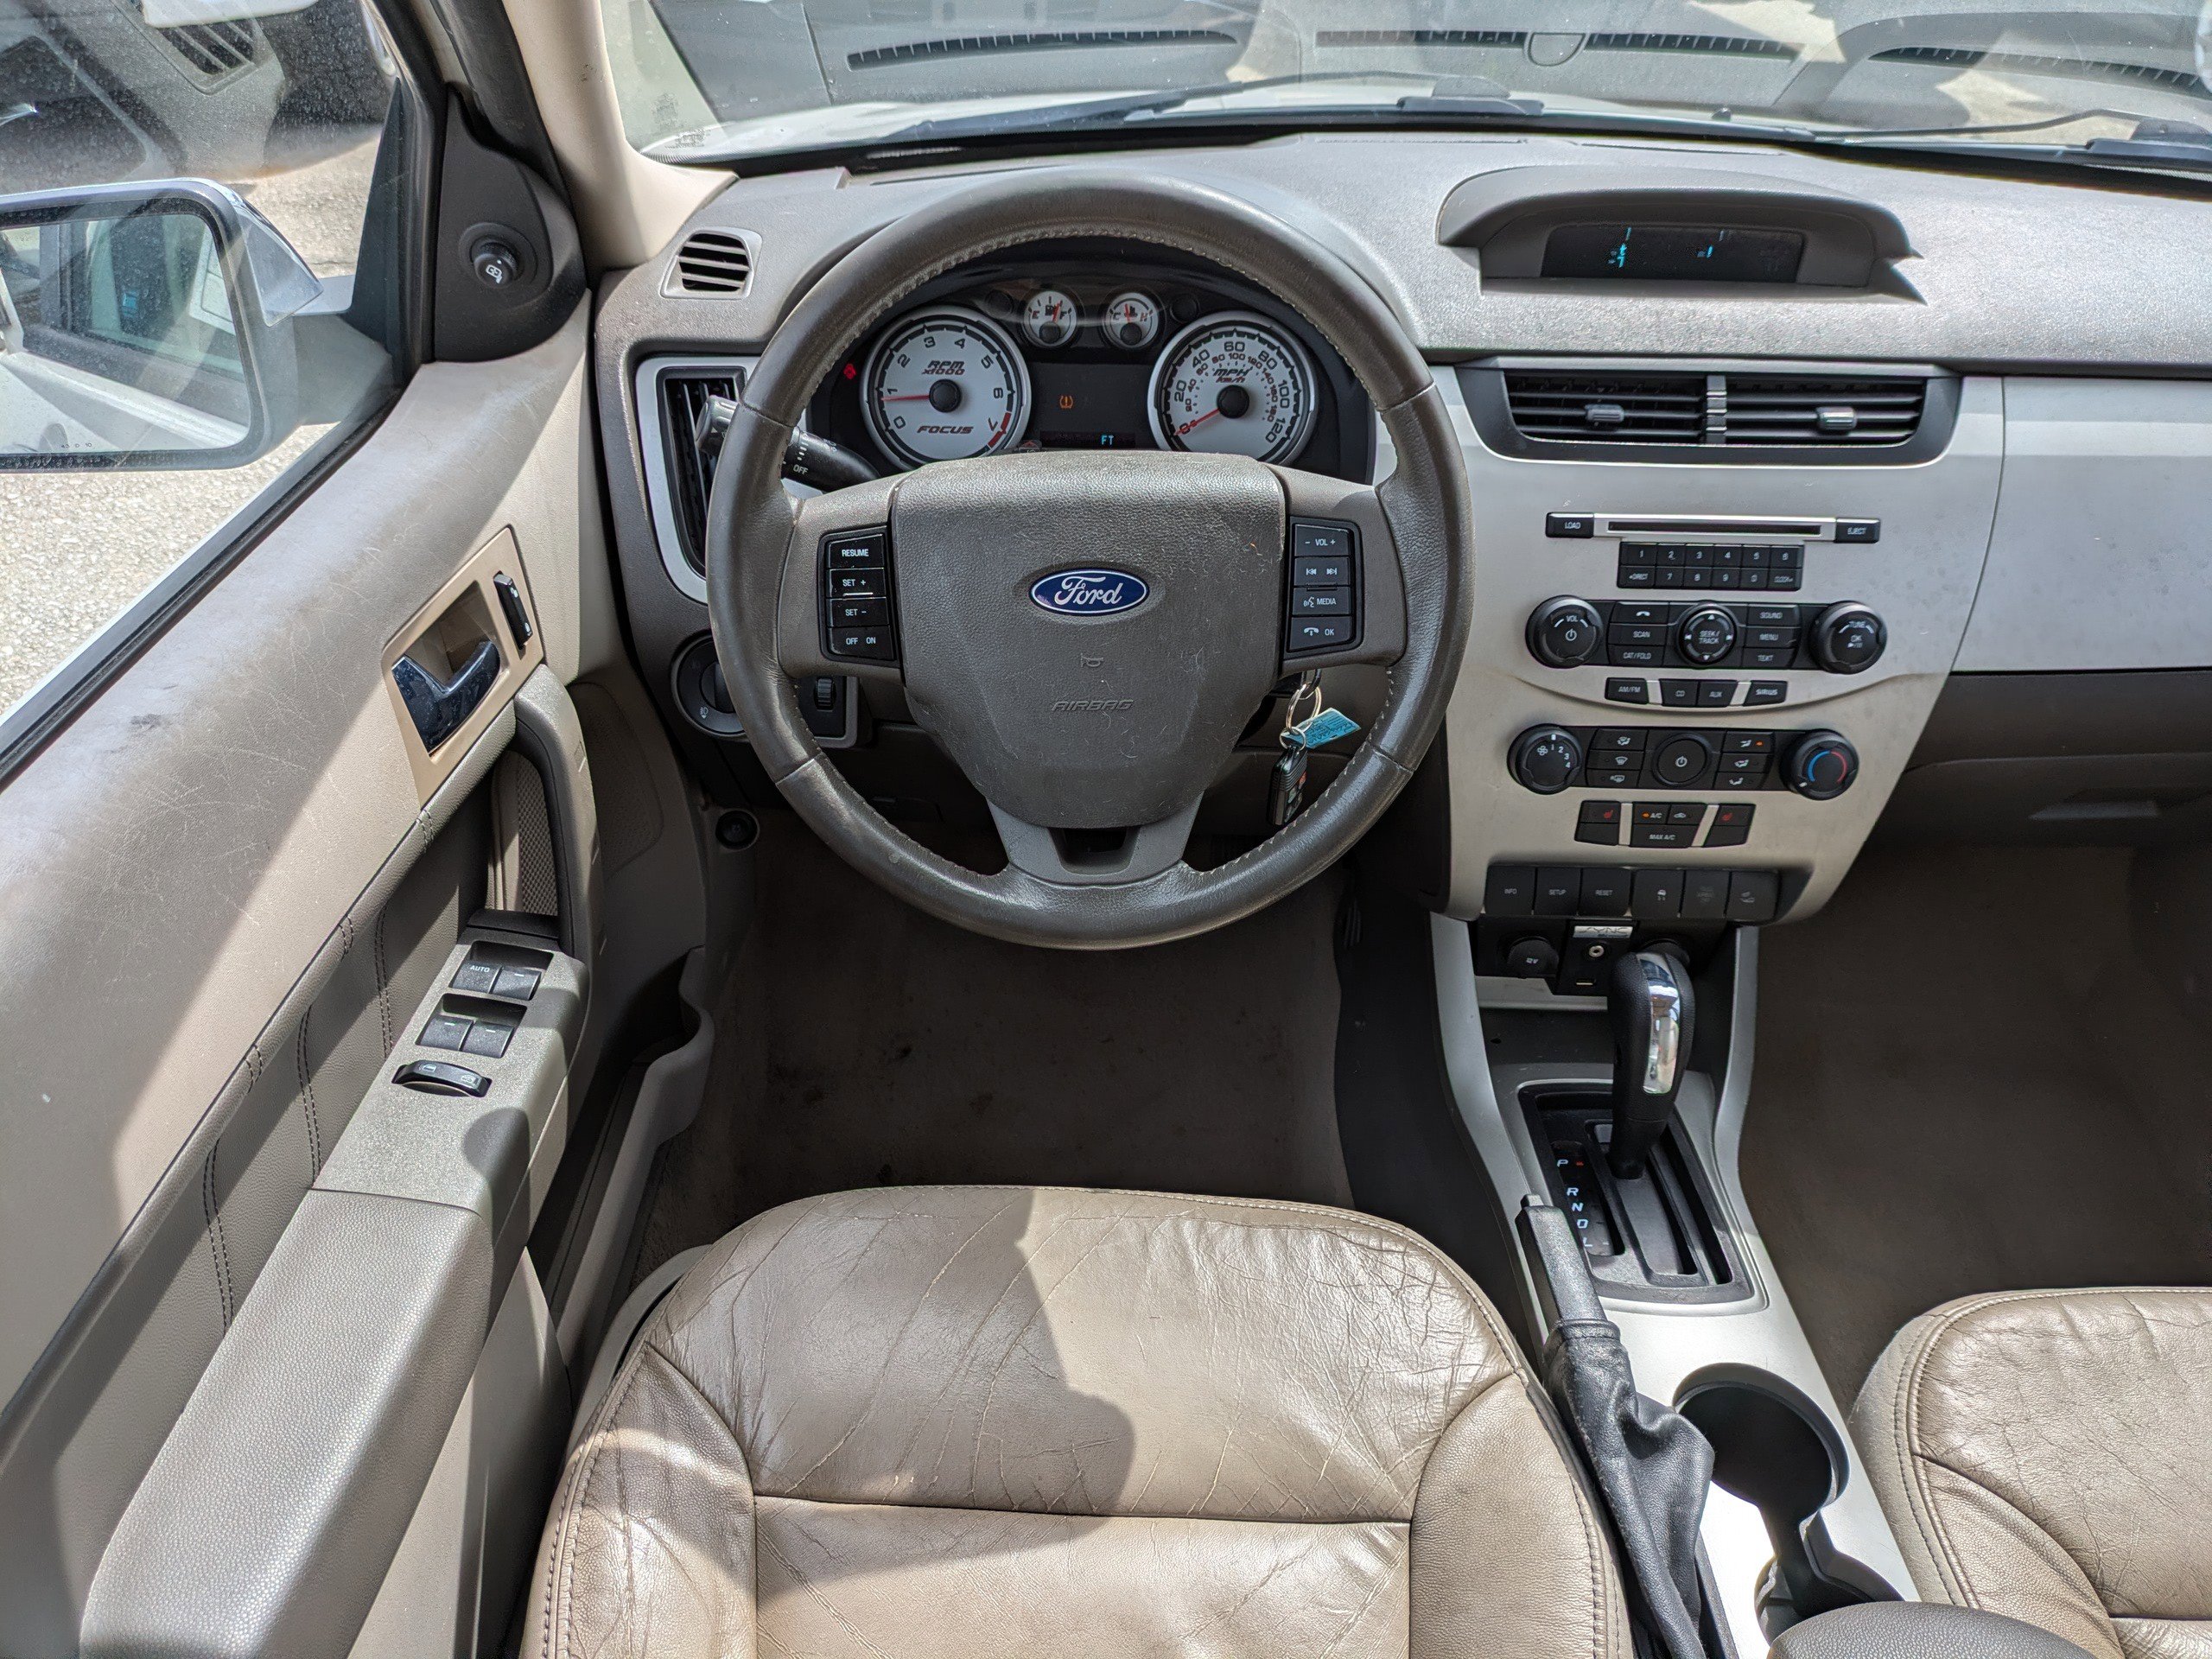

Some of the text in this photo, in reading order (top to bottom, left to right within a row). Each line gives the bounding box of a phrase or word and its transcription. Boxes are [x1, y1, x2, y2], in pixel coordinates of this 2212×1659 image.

[923, 336, 937, 349] 3
[954, 337, 966, 350] 4
[1224, 340, 1246, 353] 60
[897, 353, 912, 369] 2
[926, 359, 965, 368] RPM
[980, 354, 995, 370] 5
[1192, 349, 1211, 368] 40
[1257, 350, 1278, 371] 80
[1212, 368, 1249, 377] MPH
[993, 387, 1004, 400] 6
[1173, 379, 1187, 403] 20
[1278, 378, 1290, 410] 100
[893, 416, 906, 429] 0
[987, 417, 999, 432] 7
[916, 425, 974, 435] FOCUS
[1265, 417, 1286, 443] 120
[1101, 434, 1115, 446] FT
[793, 465, 809, 475] OFF
[842, 548, 869, 557] RESUME
[1695, 551, 1703, 560] 3
[1724, 551, 1732, 560] 4
[1666, 572, 1673, 581] 7
[842, 579, 856, 588] SET
[1054, 575, 1123, 605] Ford
[1316, 597, 1337, 606] MEDIA
[845, 608, 858, 617] SET
[866, 636, 876, 645] ON
[1051, 700, 1135, 712] AIRBAG
[470, 964, 491, 973] AUTO
[1557, 1159, 1569, 1167] P
[1566, 1187, 1580, 1197] R
[1571, 1202, 1585, 1212] N
[1576, 1218, 1589, 1229] D
[1583, 1237, 1593, 1248] L
